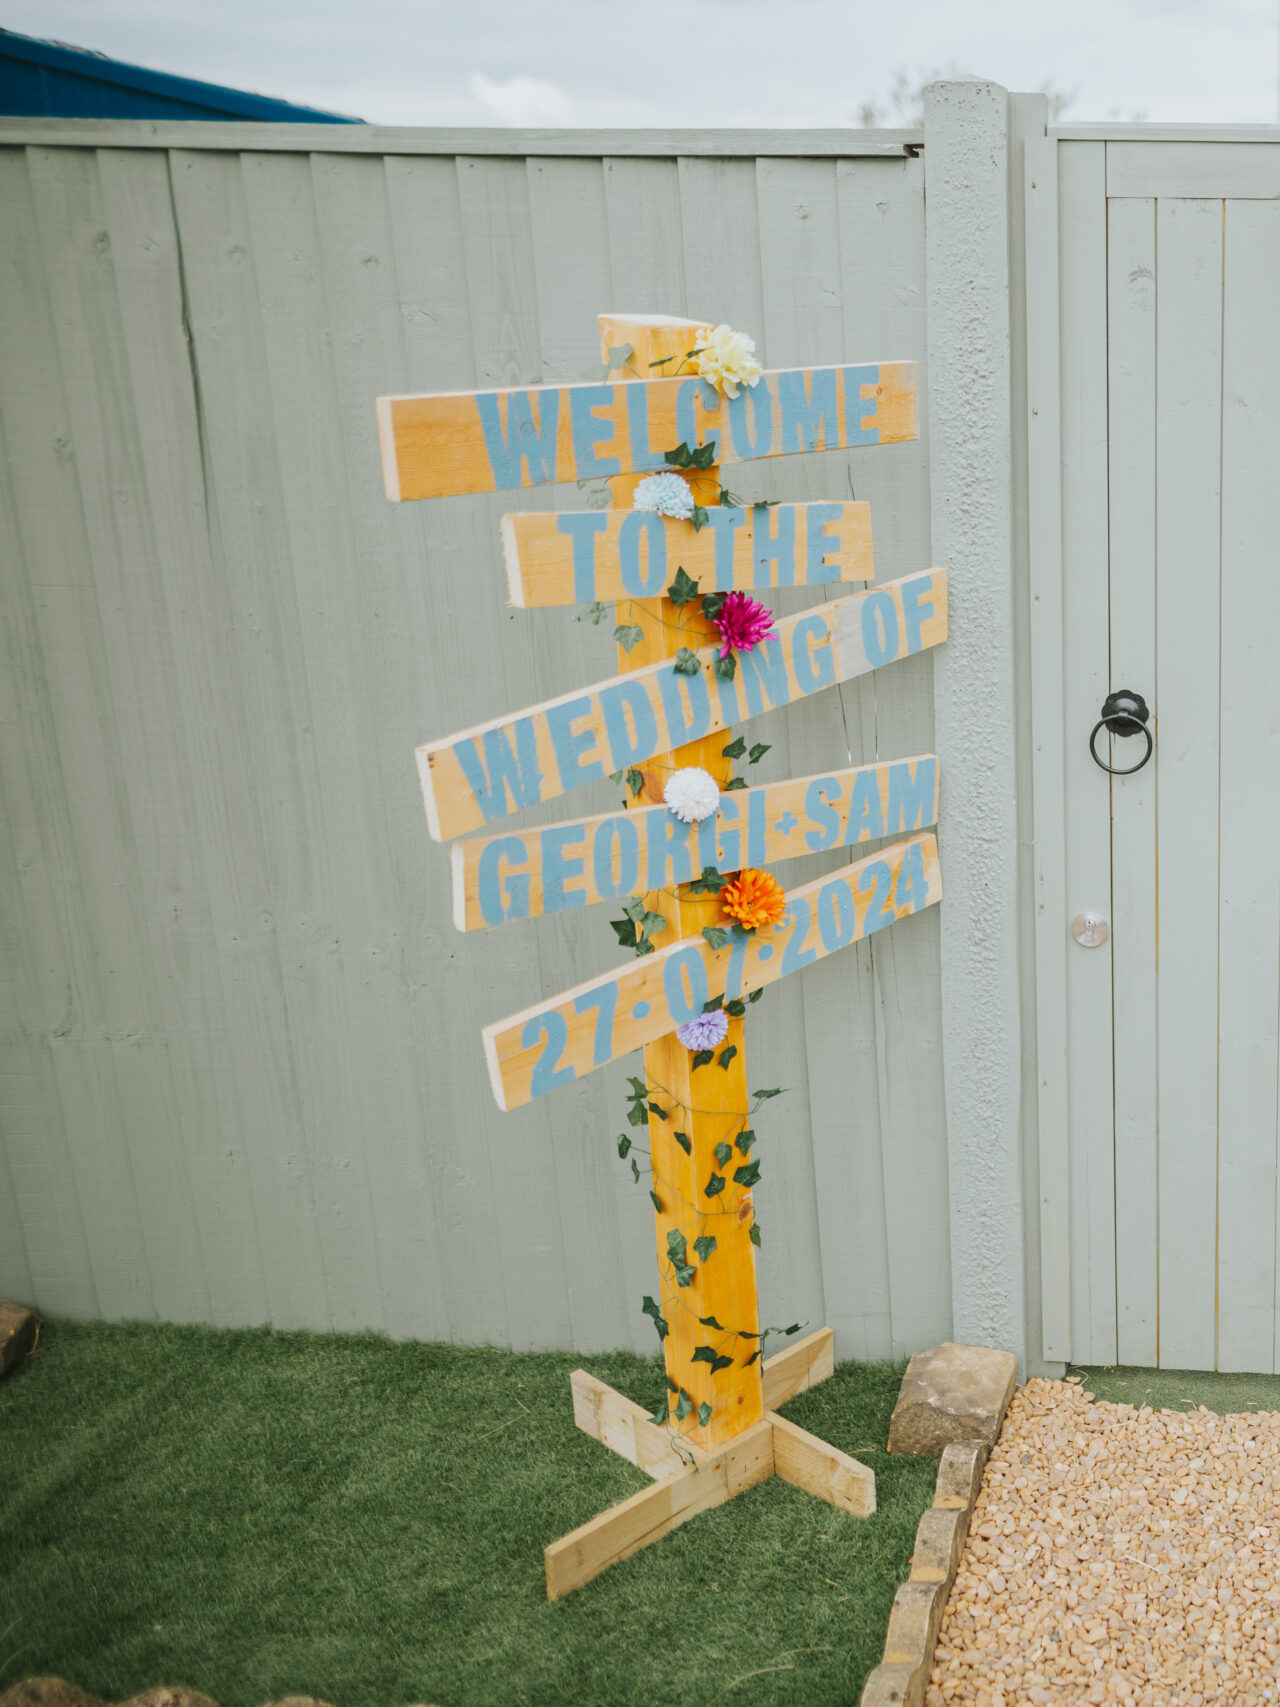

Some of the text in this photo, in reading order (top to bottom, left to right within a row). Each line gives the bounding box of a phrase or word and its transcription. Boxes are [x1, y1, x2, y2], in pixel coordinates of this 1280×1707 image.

[475, 365, 880, 491] WELCOME
[556, 503, 844, 603] TO THE
[453, 574, 936, 825] WEDDING OF
